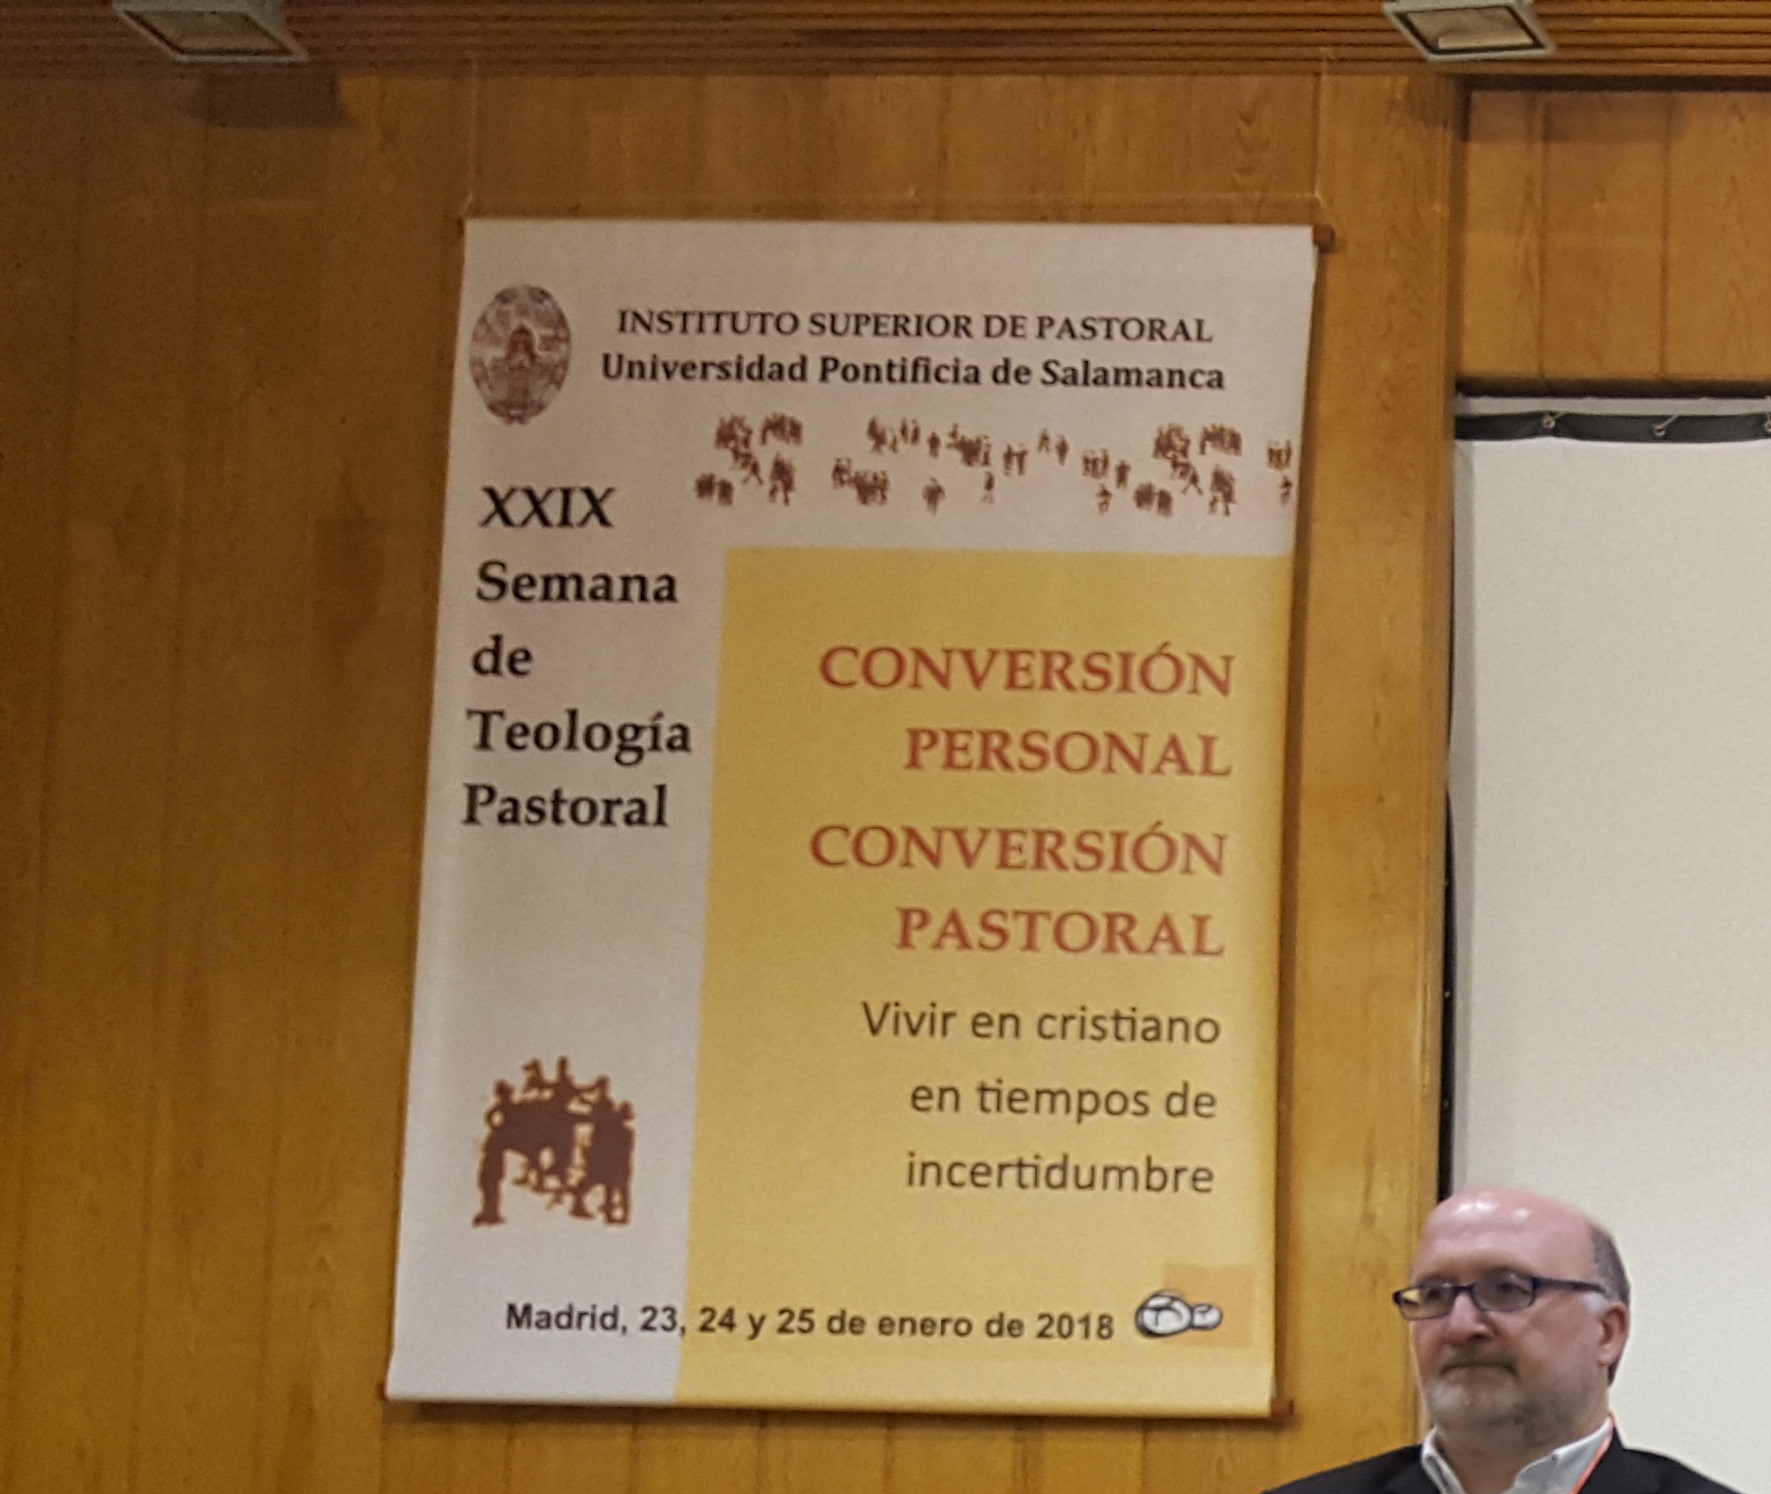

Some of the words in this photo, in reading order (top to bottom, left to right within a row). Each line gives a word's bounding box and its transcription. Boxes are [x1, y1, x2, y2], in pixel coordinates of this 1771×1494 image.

[618, 310, 799, 335] INSTITUTO
[809, 313, 972, 338] SUPERIOR
[984, 315, 1026, 338] DE
[1036, 316, 1212, 342] PASTORAL
[603, 353, 807, 382] Universidad
[819, 356, 980, 384] Pontificia
[992, 358, 1031, 385] de
[1041, 359, 1224, 389] Salamanca
[481, 487, 614, 528] XXIX
[477, 561, 677, 603] Semana
[472, 634, 532, 677] de
[818, 641, 1233, 695] CONVERSIÓN
[467, 709, 690, 766] Teología
[903, 727, 1230, 776] PERSONAL
[463, 784, 666, 826] Pastoral
[808, 821, 1225, 874] CONVERSIÓN
[894, 906, 1223, 955] PASTORAL
[862, 1001, 957, 1037] Vivir
[971, 1012, 1020, 1039] en
[1037, 1005, 1220, 1043] cristiano
[911, 1085, 960, 1112] en
[976, 1078, 1149, 1124] tiempos
[1165, 1081, 1216, 1118] de
[907, 1151, 1213, 1193] incertidumbre
[507, 1303, 627, 1335] Madrid,
[640, 1306, 686, 1337] 23,
[699, 1307, 736, 1333] 24
[748, 1314, 766, 1340] y
[777, 1308, 815, 1334] 25
[827, 1310, 866, 1335] de
[878, 1316, 972, 1337] enero
[985, 1312, 1024, 1338] de
[1036, 1313, 1113, 1340] 2018
